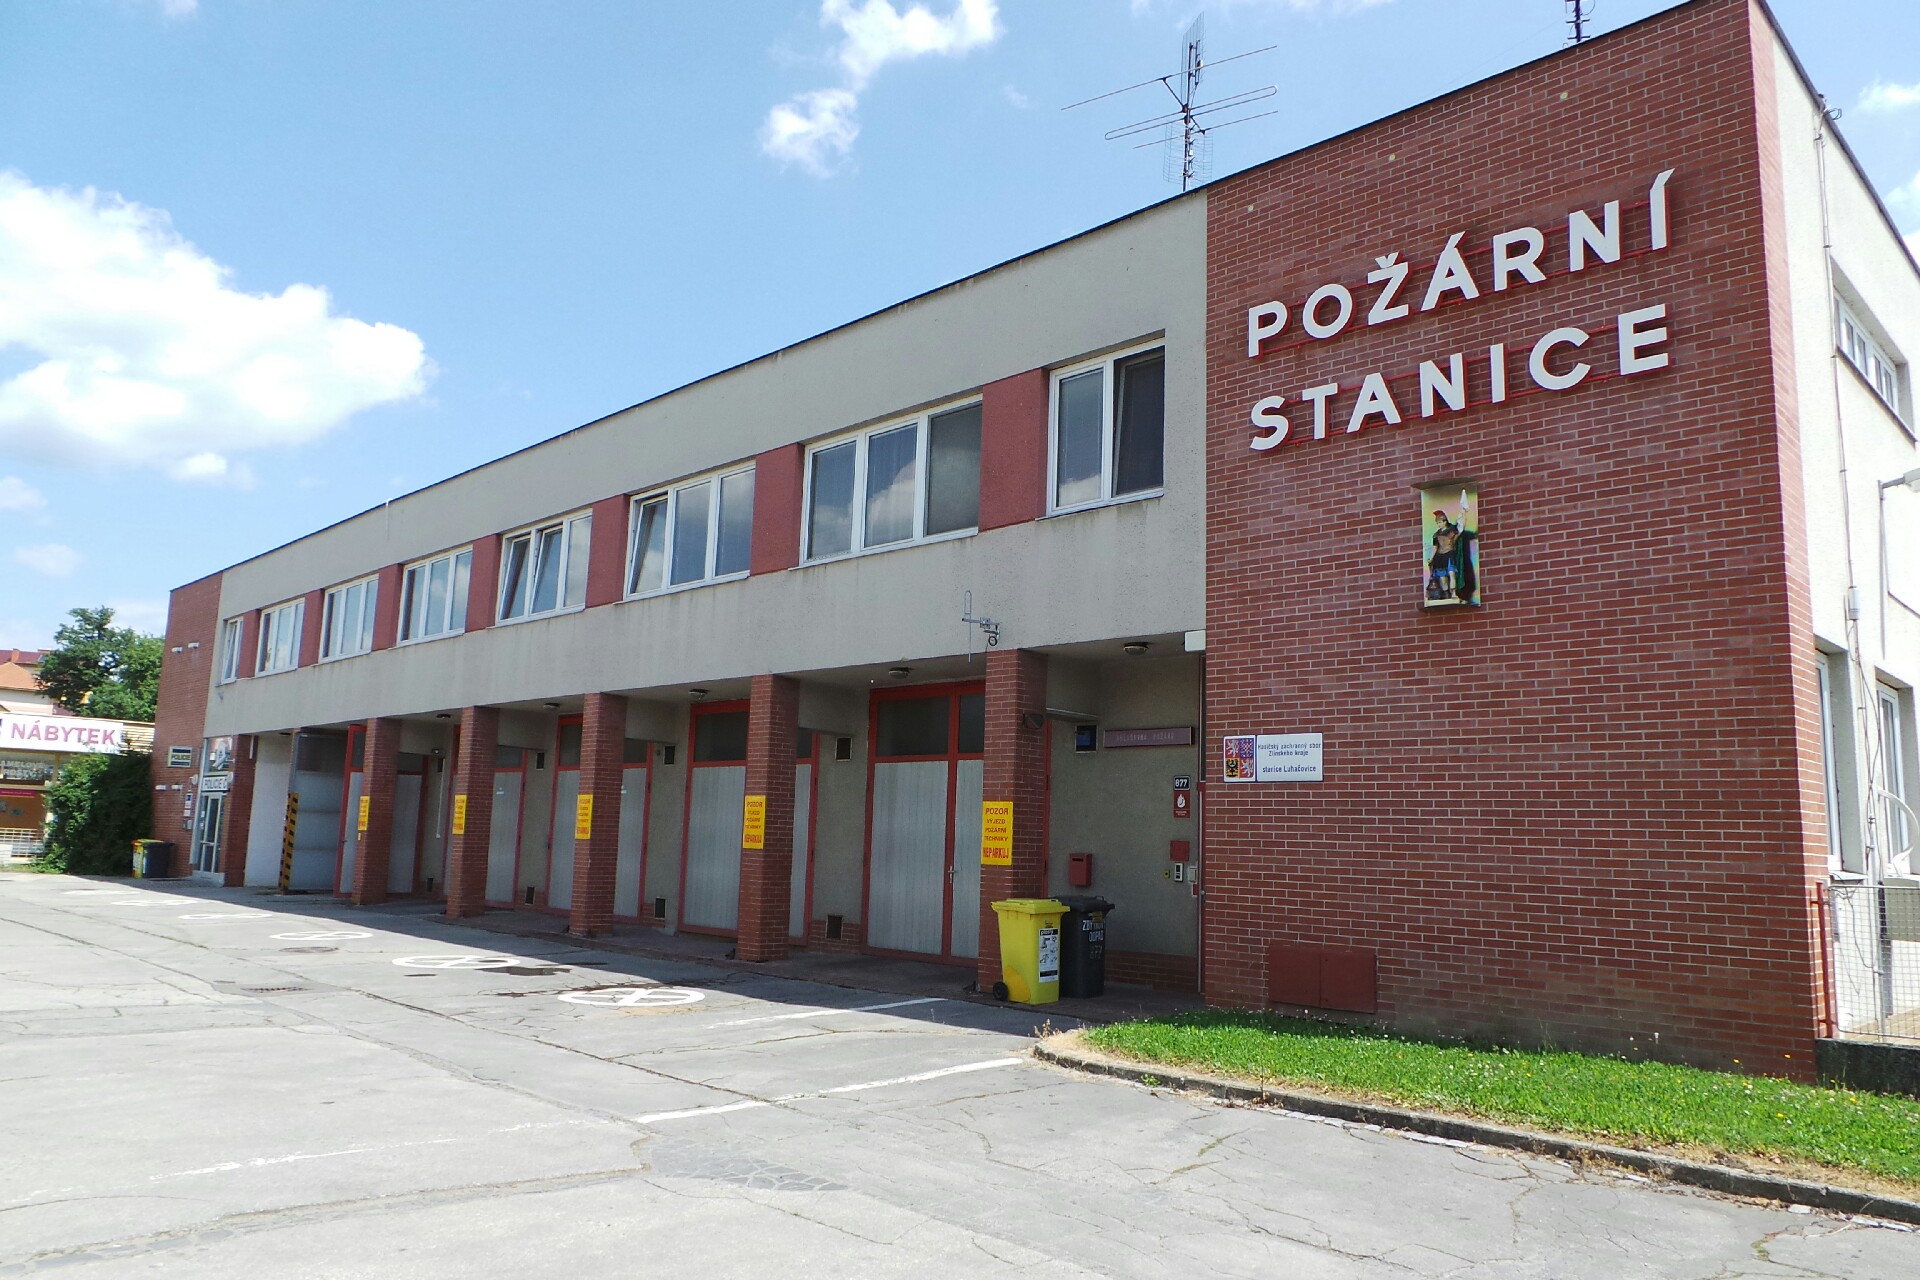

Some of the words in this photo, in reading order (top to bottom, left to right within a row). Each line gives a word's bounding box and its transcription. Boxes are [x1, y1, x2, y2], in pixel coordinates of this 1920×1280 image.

[1248, 168, 1675, 358] POŽÁRNÍ
[1250, 303, 1669, 450] STANICE
[10, 719, 116, 745] NÁBYTEK
[1284, 764, 1316, 772] Luhačovice
[204, 778, 223, 790] POLICIE
[1175, 778, 1188, 788] 877
[984, 848, 1009, 858] NEPARKUJ
